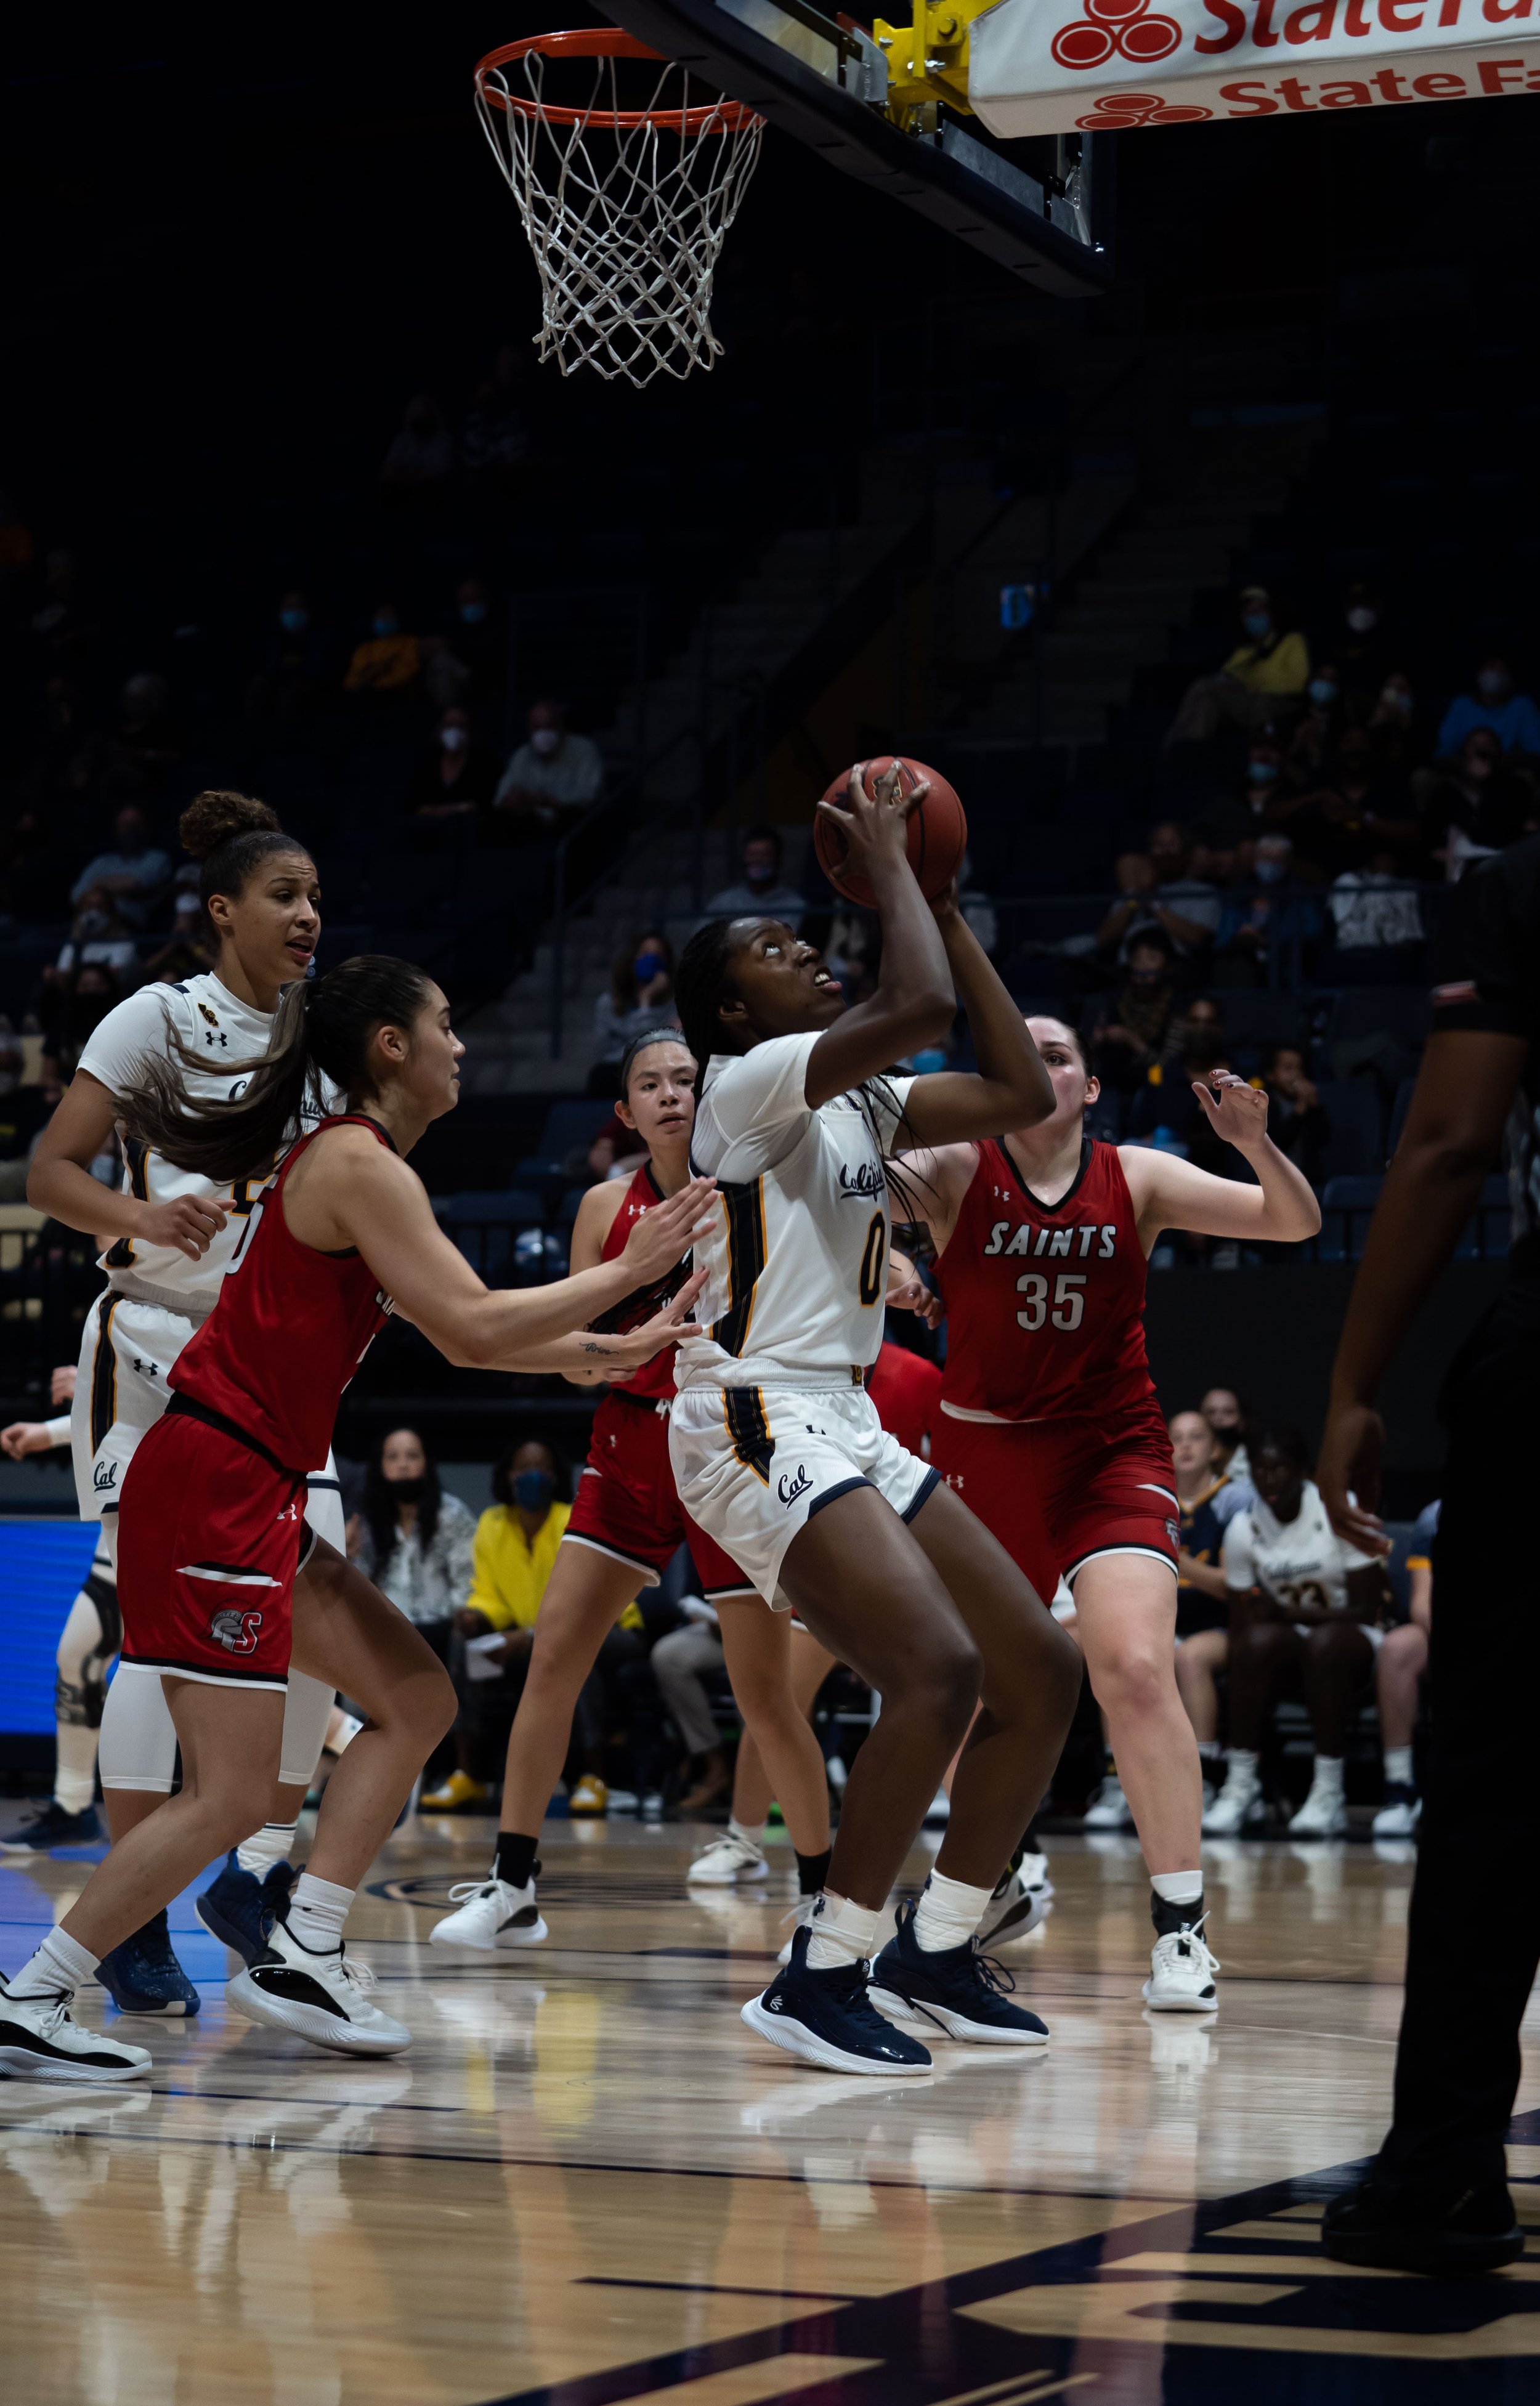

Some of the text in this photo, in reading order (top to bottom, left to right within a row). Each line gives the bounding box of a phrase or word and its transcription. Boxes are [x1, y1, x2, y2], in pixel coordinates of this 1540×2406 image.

[1219, 60, 1540, 116] State F
[858, 1209, 885, 1308] 0
[984, 1217, 1117, 1258] SAINTS
[1016, 1273, 1088, 1332] 35
[94, 1460, 117, 1493] Cal
[777, 1464, 814, 1510] Cal
